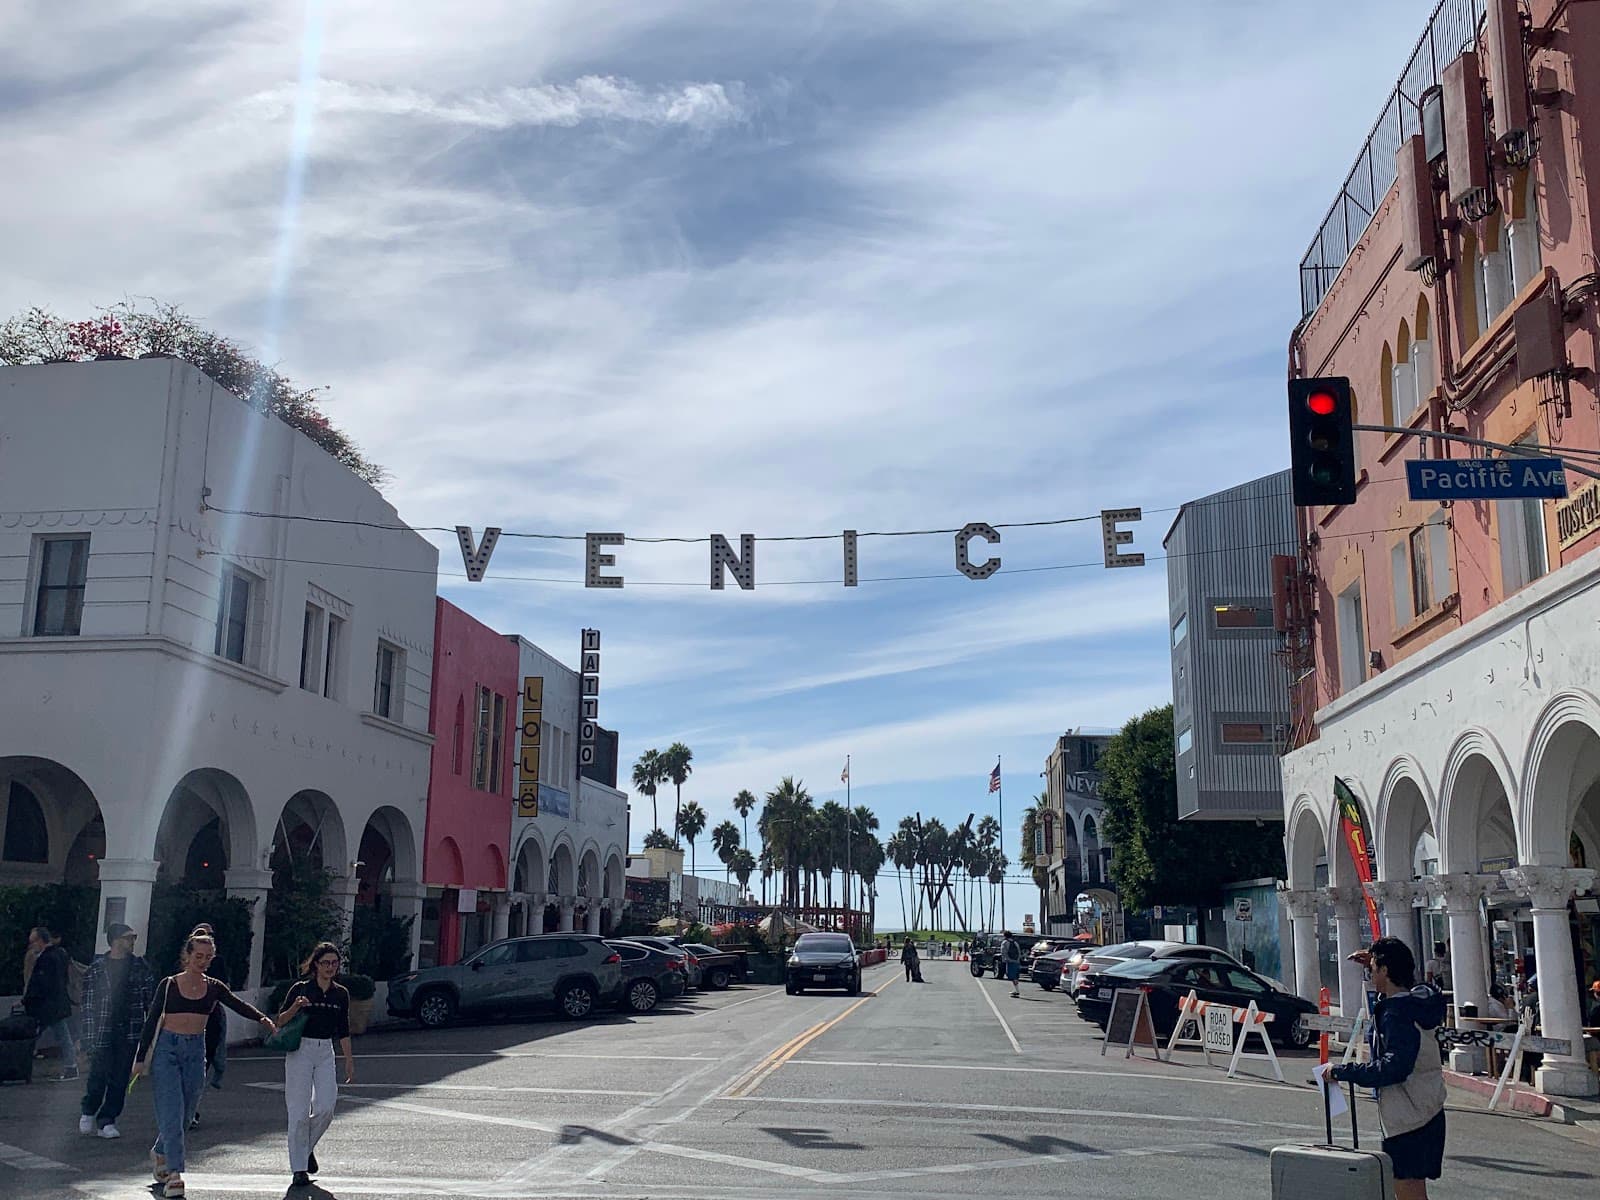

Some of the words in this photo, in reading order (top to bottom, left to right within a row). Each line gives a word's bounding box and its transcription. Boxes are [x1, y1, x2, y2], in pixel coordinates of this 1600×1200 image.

[1420, 467, 1512, 489] Pacific
[455, 507, 1145, 590] VENICE
[582, 631, 598, 762] TATTOO
[1210, 1012, 1227, 1026] ROAD
[1206, 1031, 1231, 1046] CLOSED
